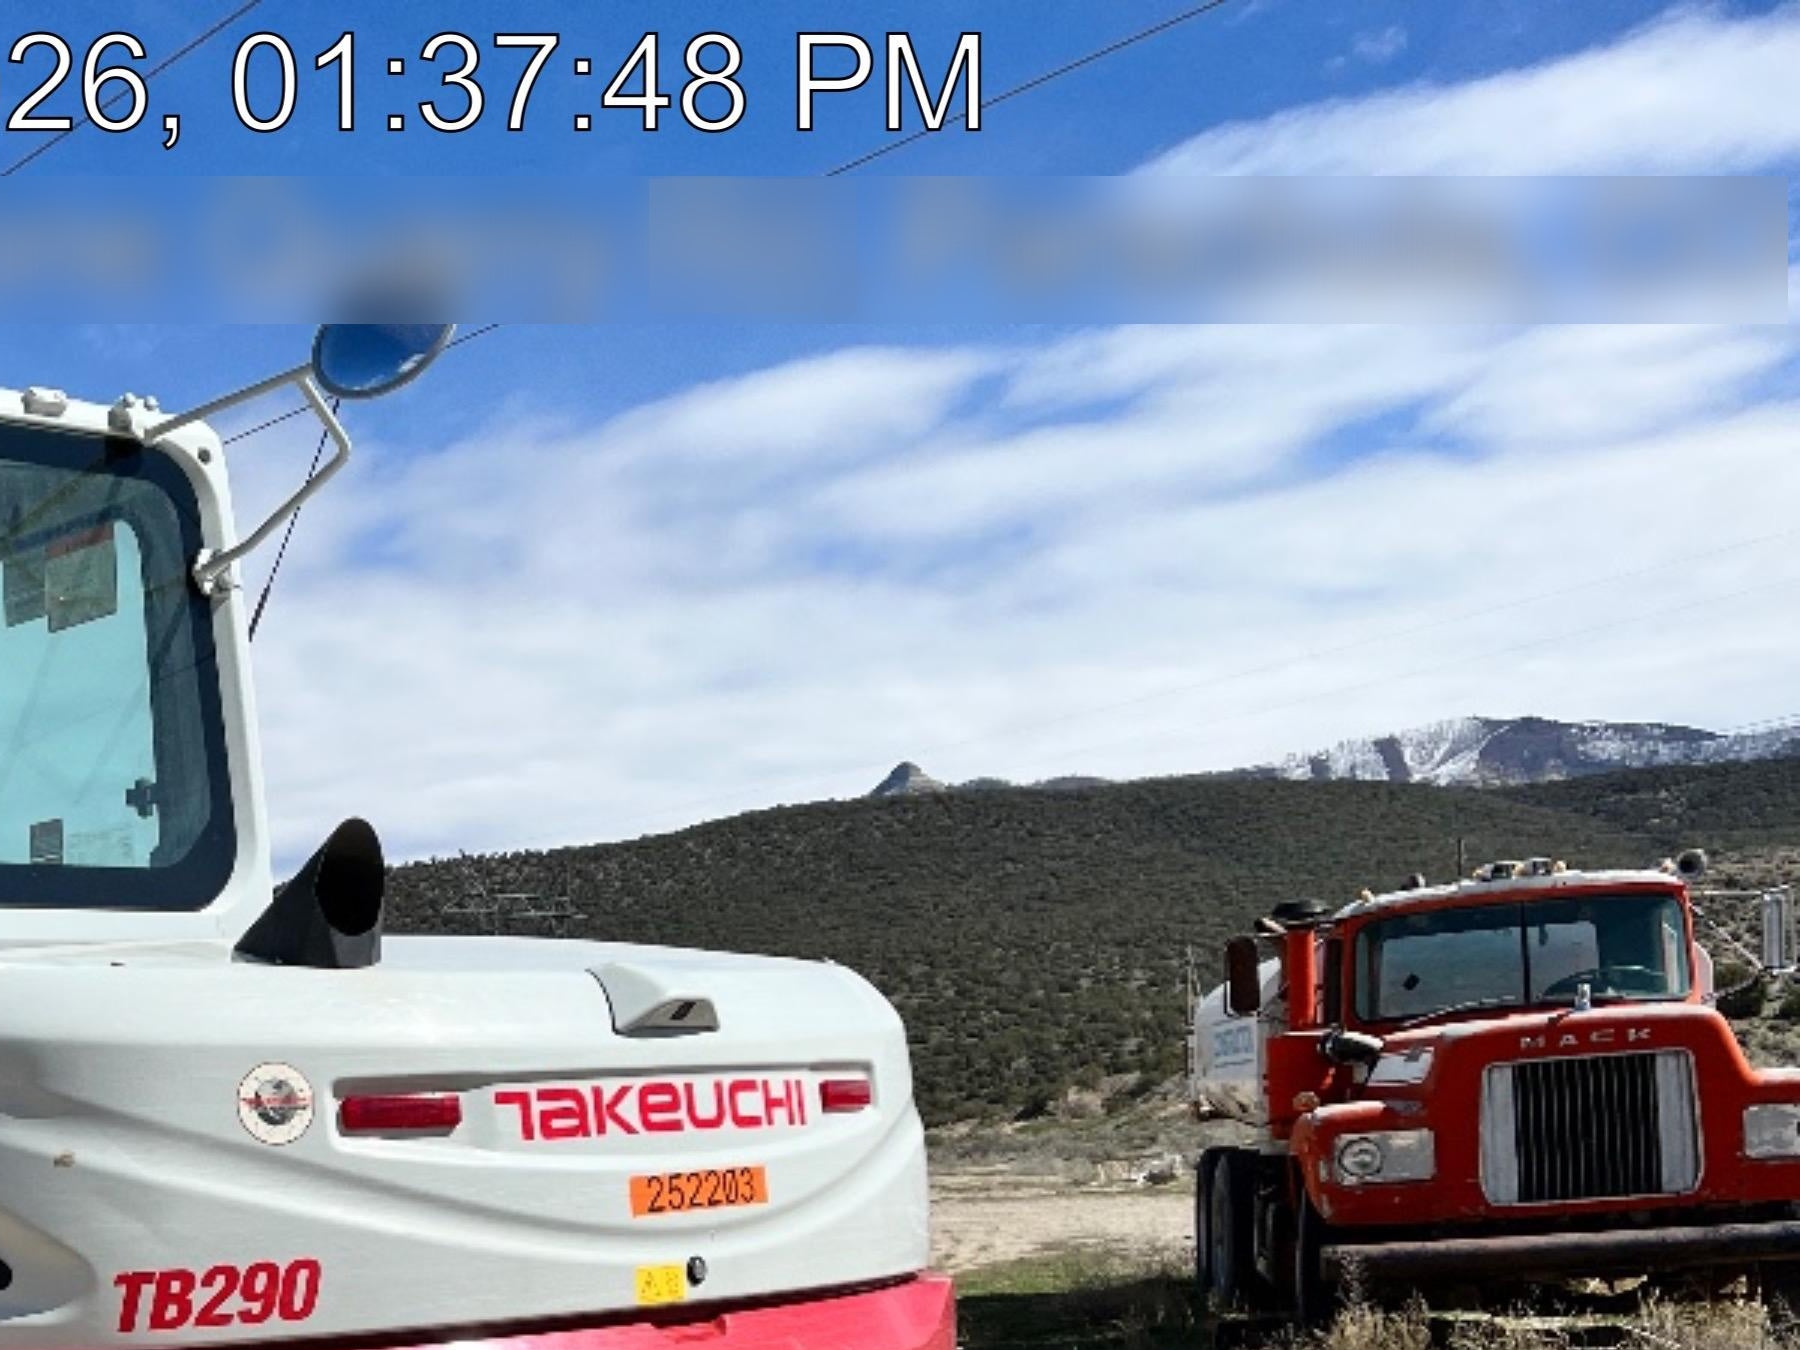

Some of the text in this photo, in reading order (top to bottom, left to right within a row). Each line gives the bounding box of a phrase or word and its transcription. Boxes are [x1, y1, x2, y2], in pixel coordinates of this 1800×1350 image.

[1519, 1028, 1651, 1049] MACK
[646, 1166, 756, 1214] 252203
[112, 1257, 323, 1334] TB290
